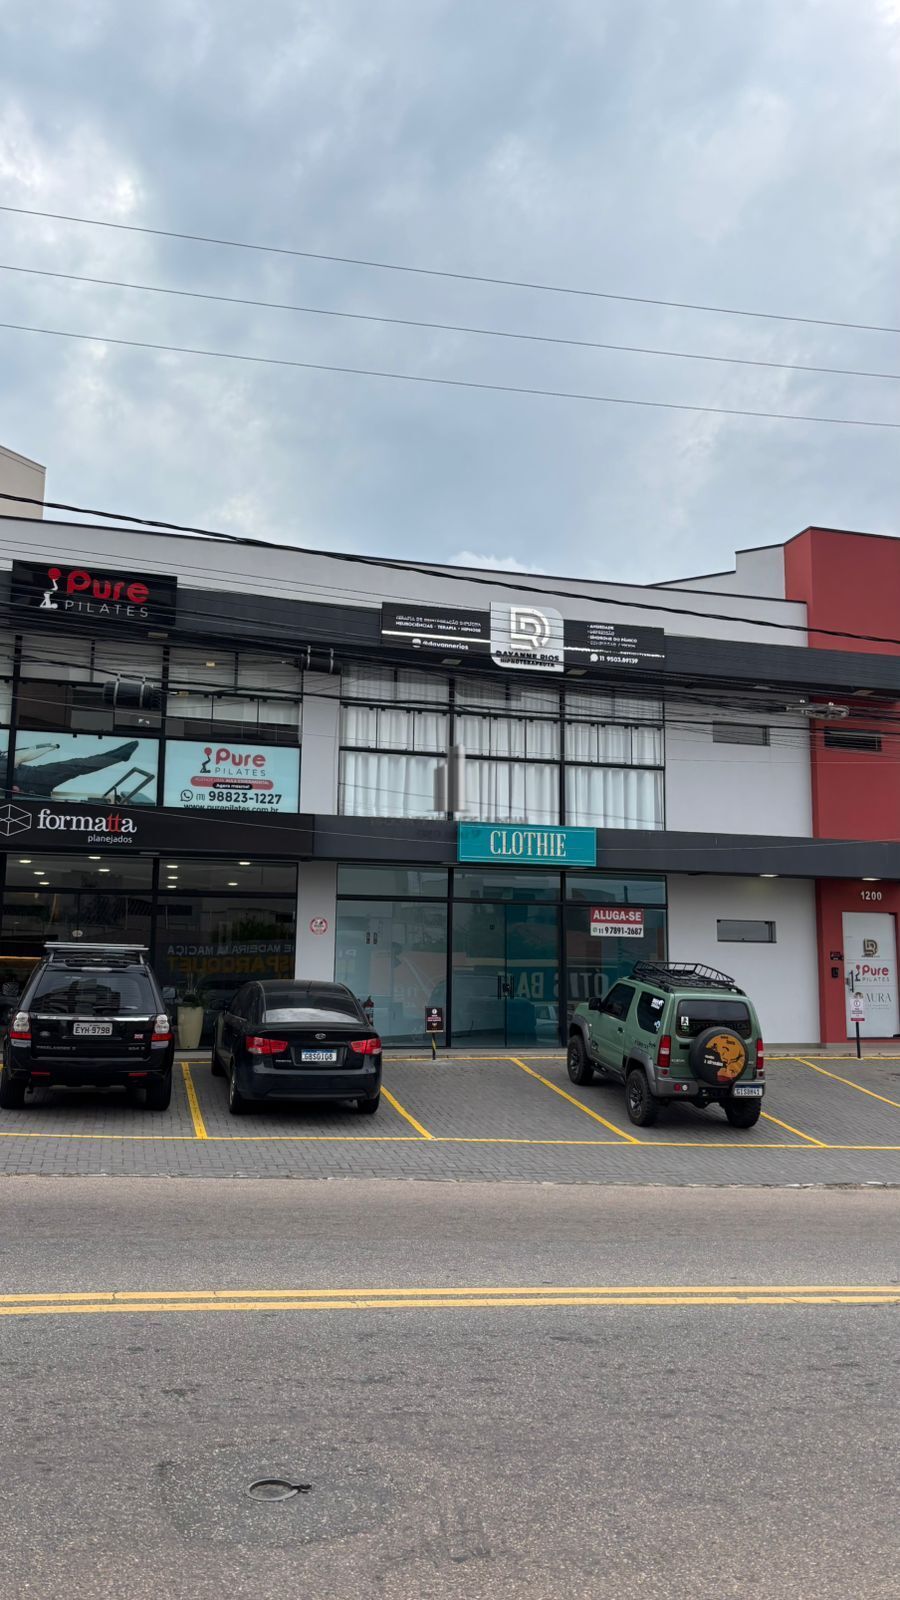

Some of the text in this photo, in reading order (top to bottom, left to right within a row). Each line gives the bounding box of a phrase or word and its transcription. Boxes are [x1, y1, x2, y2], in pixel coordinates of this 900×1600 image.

[67, 570, 150, 605] Pure
[65, 600, 149, 618] PILATES
[215, 748, 266, 767] Pure
[214, 766, 266, 776] PILATES
[208, 790, 282, 805] 98823-1227
[37, 808, 137, 833] formatta
[88, 834, 133, 844] planejados
[490, 830, 567, 857] CLOTHIE
[860, 891, 882, 901] 1200
[593, 909, 642, 921] ALUGA-SE
[862, 964, 889, 976] Pure
